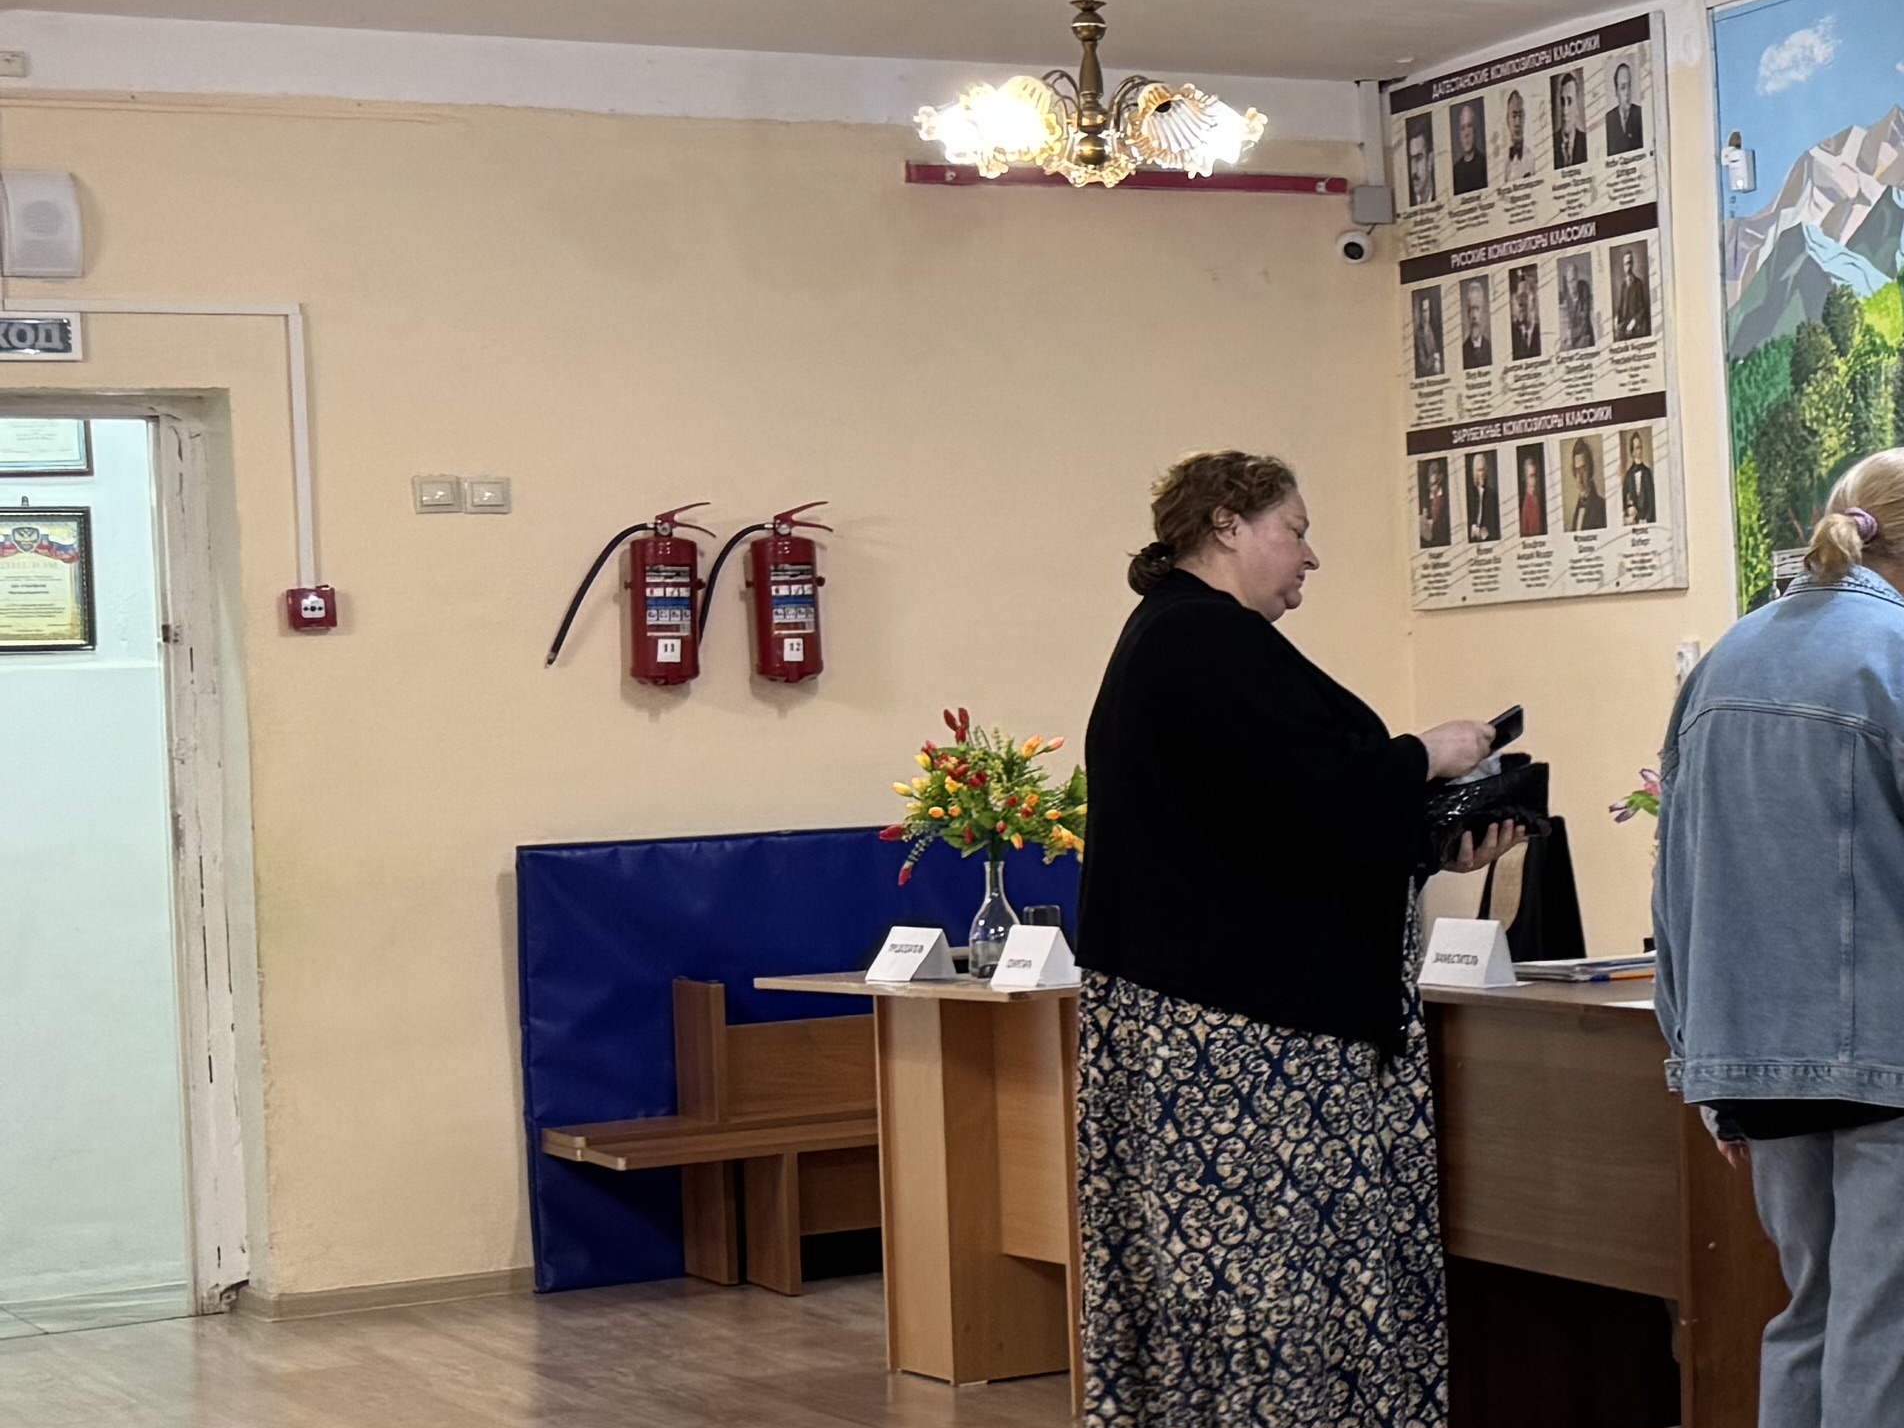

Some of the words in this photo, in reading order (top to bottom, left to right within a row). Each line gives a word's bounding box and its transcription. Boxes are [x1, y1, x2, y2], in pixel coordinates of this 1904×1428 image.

[1490, 48, 1552, 80] КОМПОЗИТОРЫ
[1553, 34, 1601, 61] КЛАССИКИ
[1488, 232, 1548, 260] КОМПОЗИТОРЫ
[1549, 221, 1597, 245] КЛАССИКИ
[1502, 412, 1564, 436] КОМПОЗИТОРЫ
[1565, 405, 1613, 427] КЛАССИКИ
